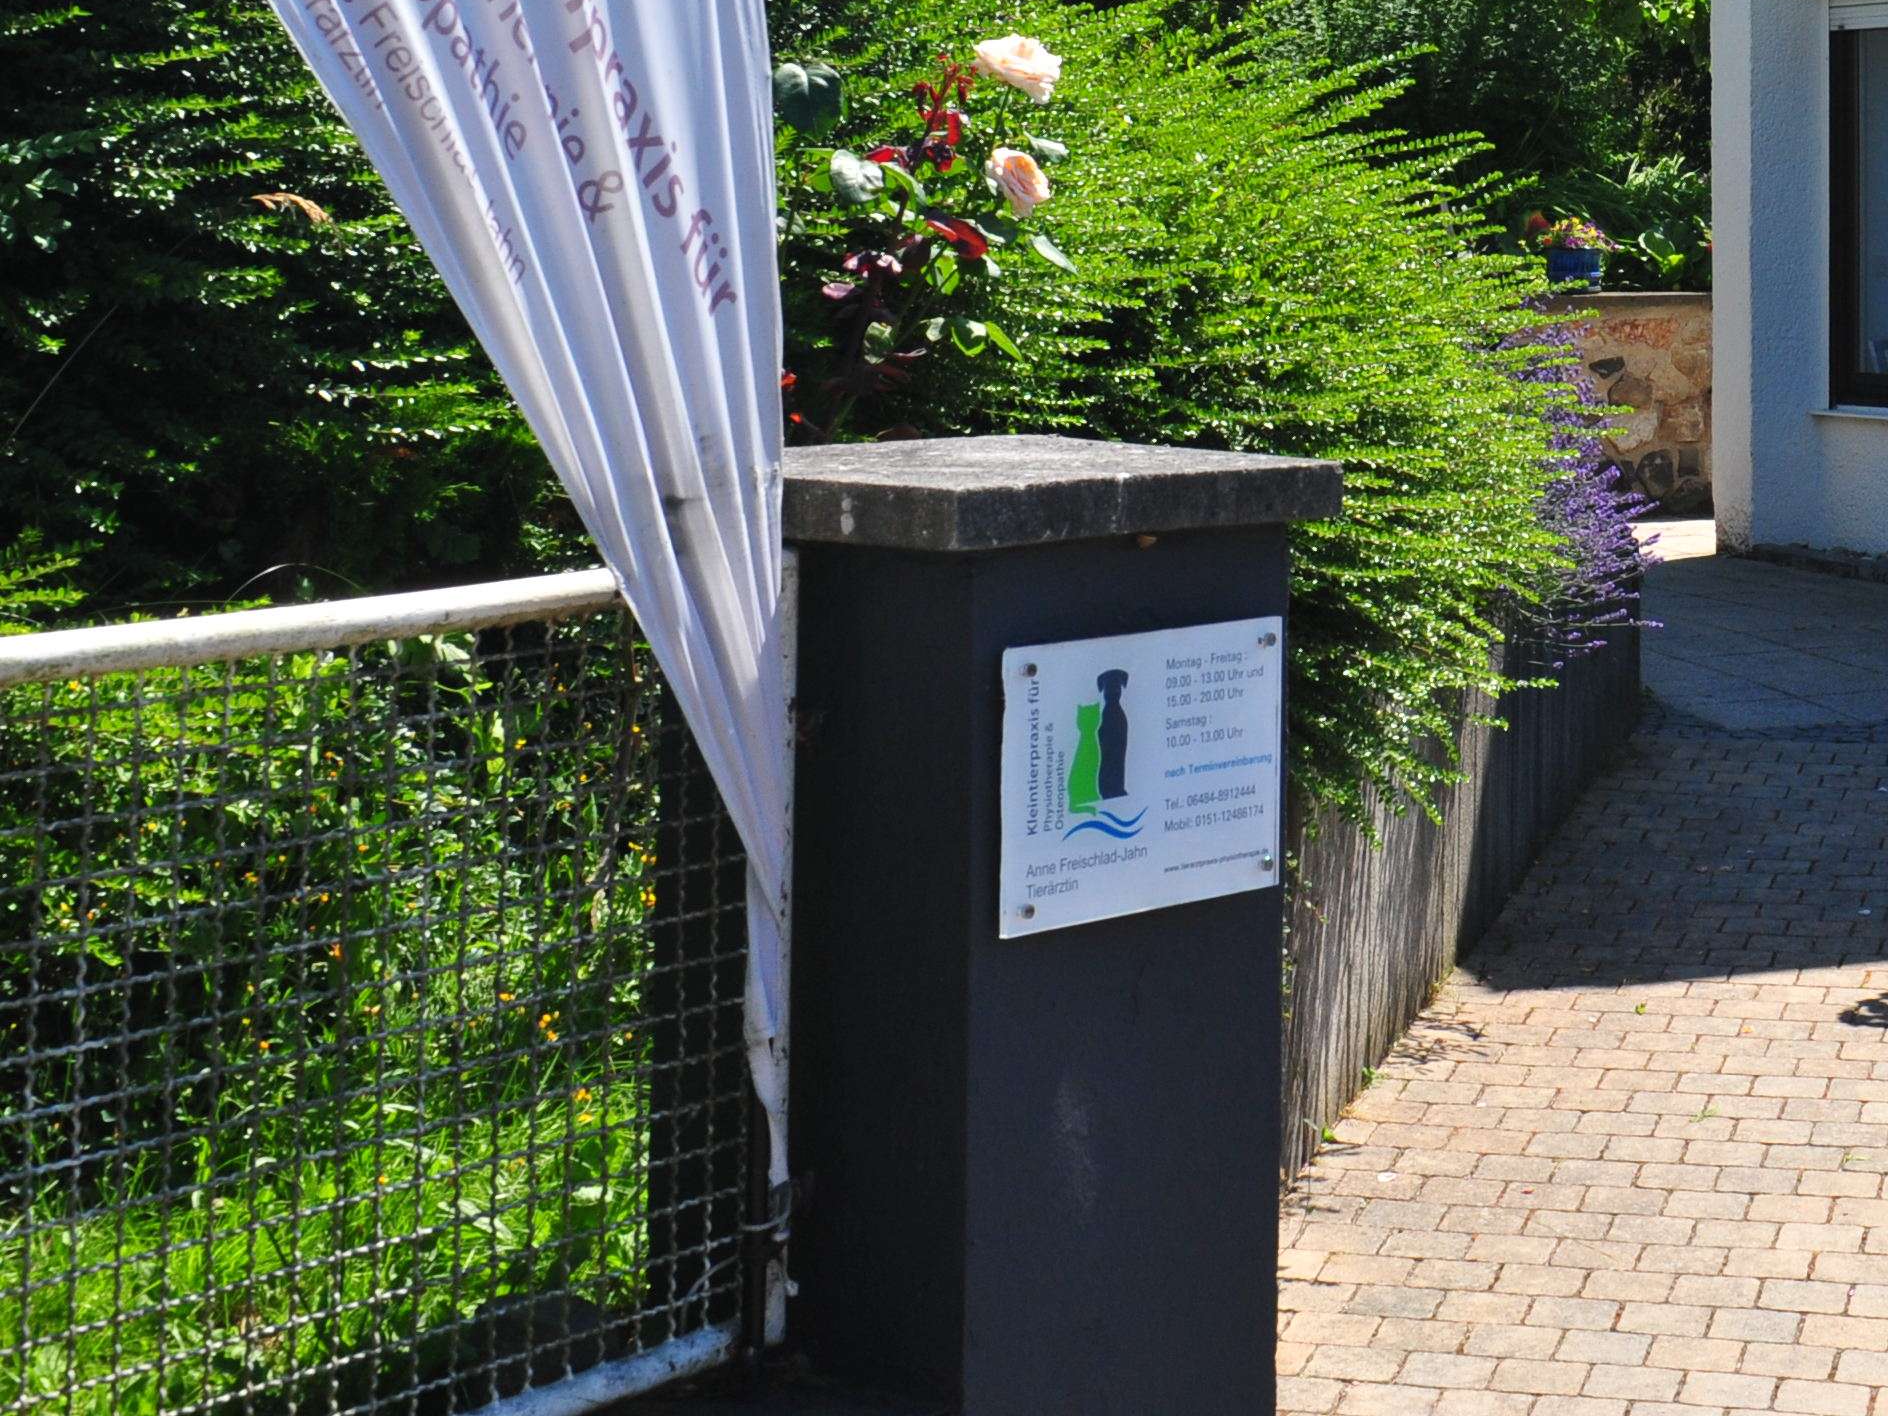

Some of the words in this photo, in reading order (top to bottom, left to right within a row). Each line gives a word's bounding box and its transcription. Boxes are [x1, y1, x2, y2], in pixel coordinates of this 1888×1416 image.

[578, 169, 624, 224] &
[680, 208, 737, 317] für
[1166, 657, 1202, 670] Montag
[1210, 652, 1242, 665] Freitag
[1200, 670, 1225, 685] 13.00
[1227, 668, 1244, 681] Uhr
[1247, 665, 1264, 679] und
[1027, 679, 1040, 704] für
[1166, 693, 1192, 707] 15.00
[1200, 688, 1225, 703] 20.00
[1227, 687, 1244, 699] Uhr
[1044, 722, 1054, 732] &
[1165, 715, 1207, 730] Samstag
[1166, 734, 1191, 748] 10.00
[1200, 729, 1225, 743] 13.00
[1227, 726, 1244, 740] Uhr
[1026, 708, 1040, 836] Kleintierpraxis
[1043, 733, 1055, 832] Physiotherapie
[1054, 750, 1067, 831] Osteopathie
[1025, 863, 1056, 878] Anne
[1059, 845, 1148, 872] Freischlad-Jahn
[1025, 878, 1079, 899] Tierärztin
